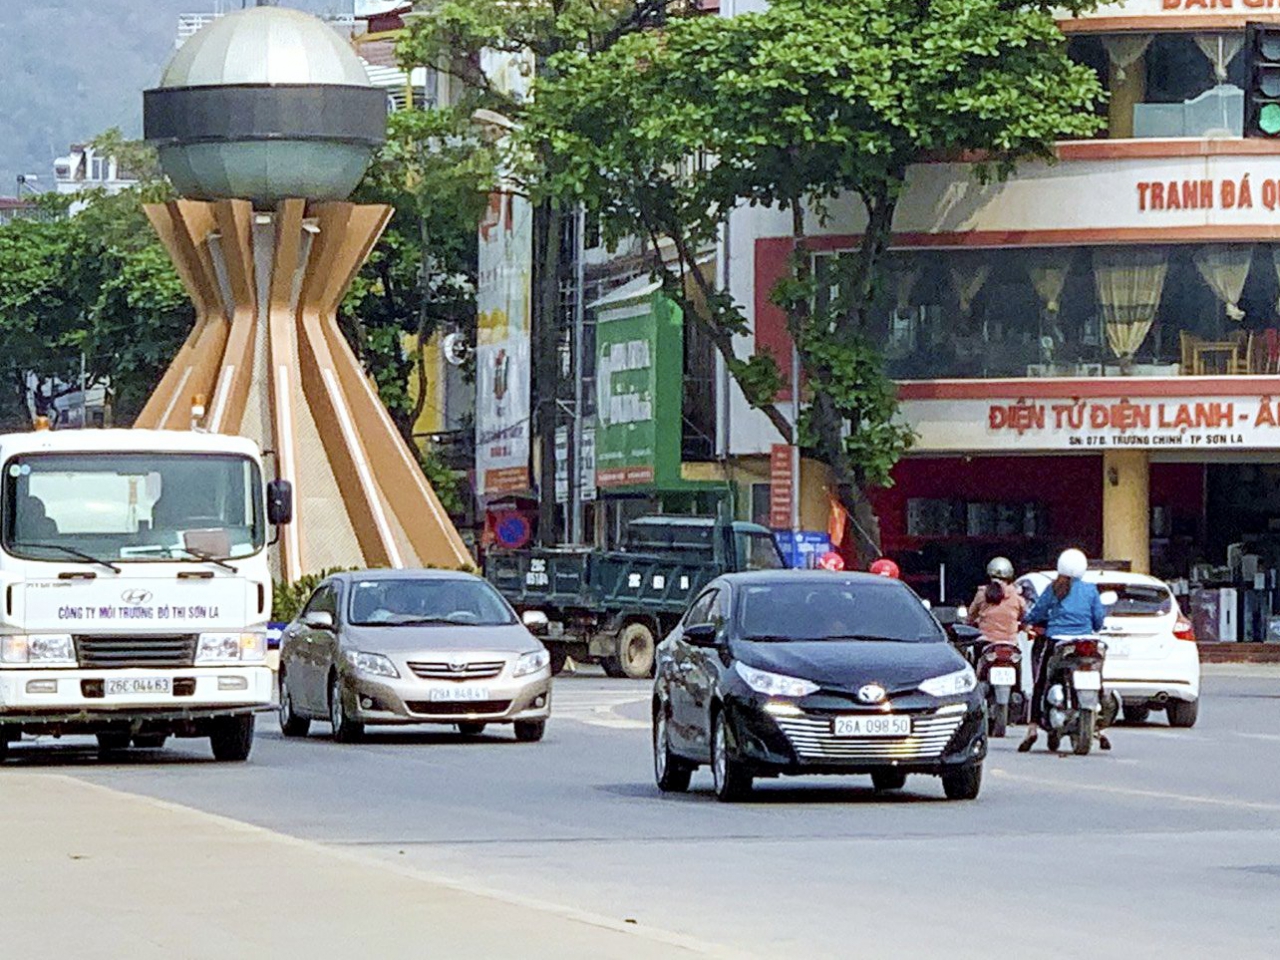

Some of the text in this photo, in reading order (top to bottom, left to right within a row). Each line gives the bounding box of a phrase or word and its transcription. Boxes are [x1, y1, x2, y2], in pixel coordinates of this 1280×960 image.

[1136, 180, 1214, 211] TRANH
[1219, 172, 1253, 209] ĐÁ
[988, 396, 1046, 436] ĐIỆN
[1089, 396, 1152, 435] ĐIỆN
[1157, 402, 1235, 435] LẠNH
[1190, 434, 1201, 444] TP
[1205, 434, 1227, 444] SƠN
[1230, 434, 1244, 444] LA
[86, 606, 95, 619] TY
[209, 606, 219, 618] LA
